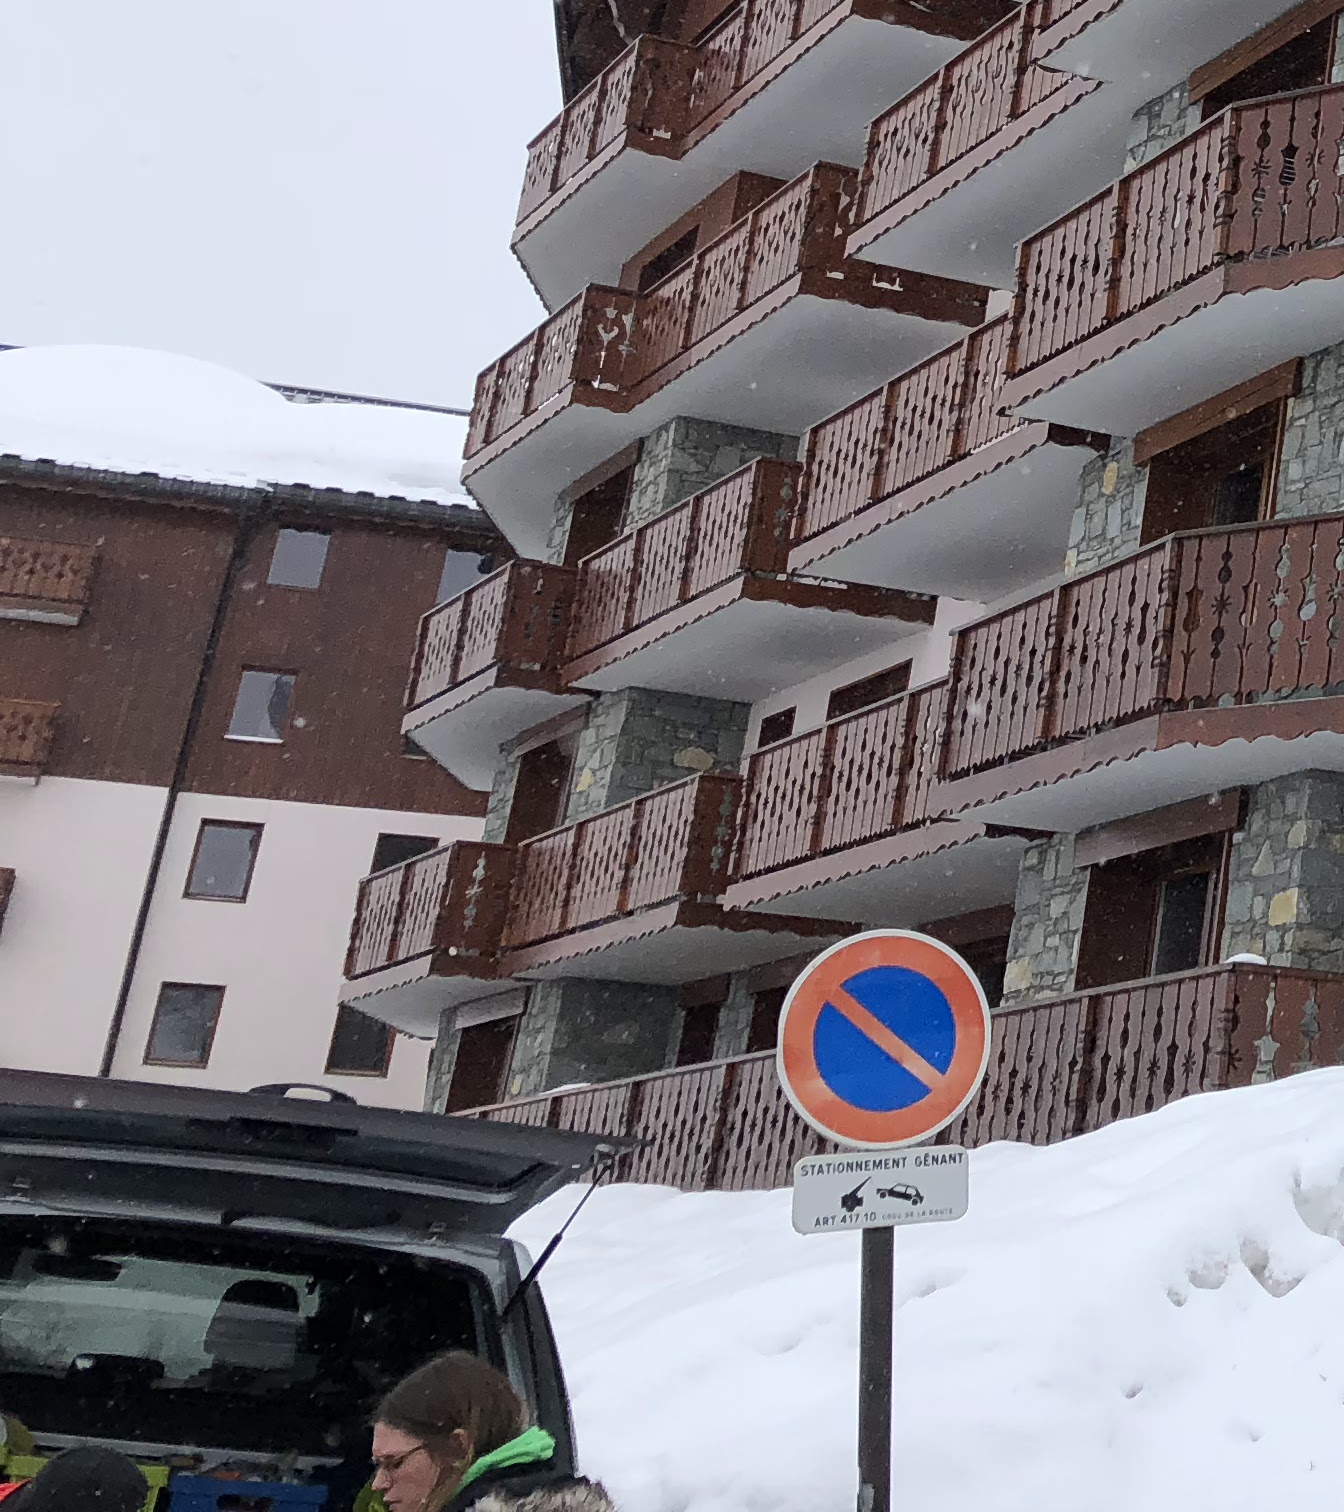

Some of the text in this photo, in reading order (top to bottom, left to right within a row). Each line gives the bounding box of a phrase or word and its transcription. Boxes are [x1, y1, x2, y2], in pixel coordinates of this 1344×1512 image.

[800, 1152, 964, 1177] STATIONNEMENT GÊNANT
[814, 1215, 837, 1228] ART
